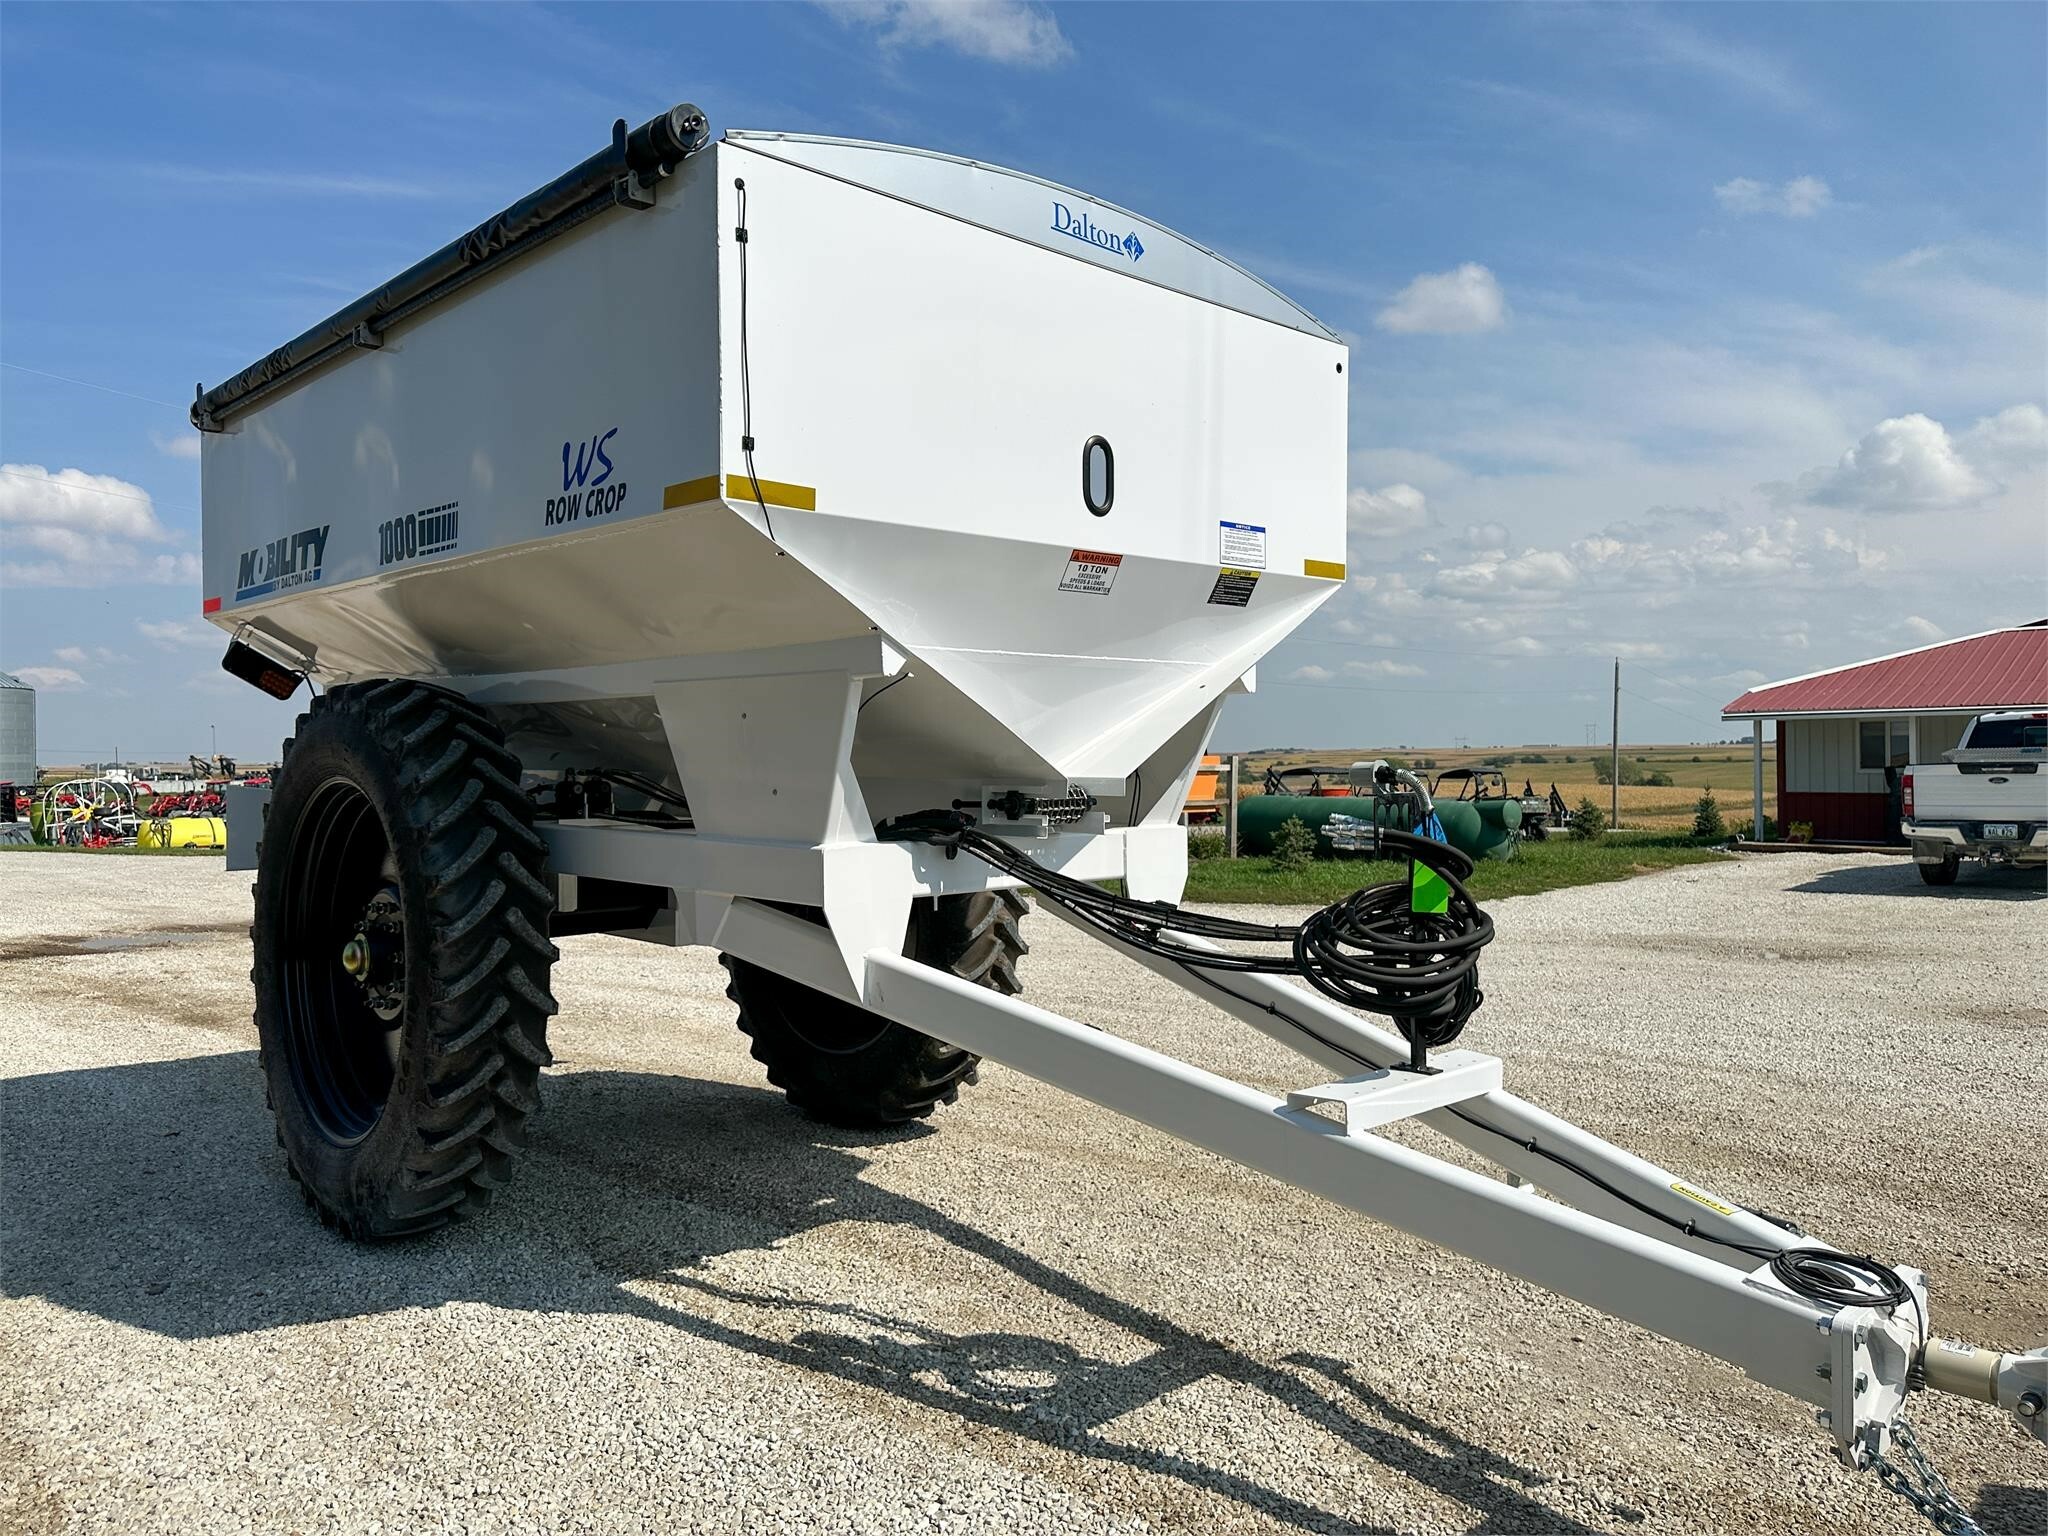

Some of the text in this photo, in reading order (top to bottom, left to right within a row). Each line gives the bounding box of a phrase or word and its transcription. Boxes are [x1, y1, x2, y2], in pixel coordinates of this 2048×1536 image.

[1052, 201, 1122, 251] Dalton
[562, 427, 618, 491] WS
[545, 482, 626, 526] ROW CROP
[237, 524, 330, 589] MOBILITY
[379, 513, 417, 566] 1000
[1082, 553, 1120, 564] WARNING
[281, 573, 302, 589] DALTON
[303, 570, 312, 583] AG
[1078, 564, 1108, 574] 10 TON
